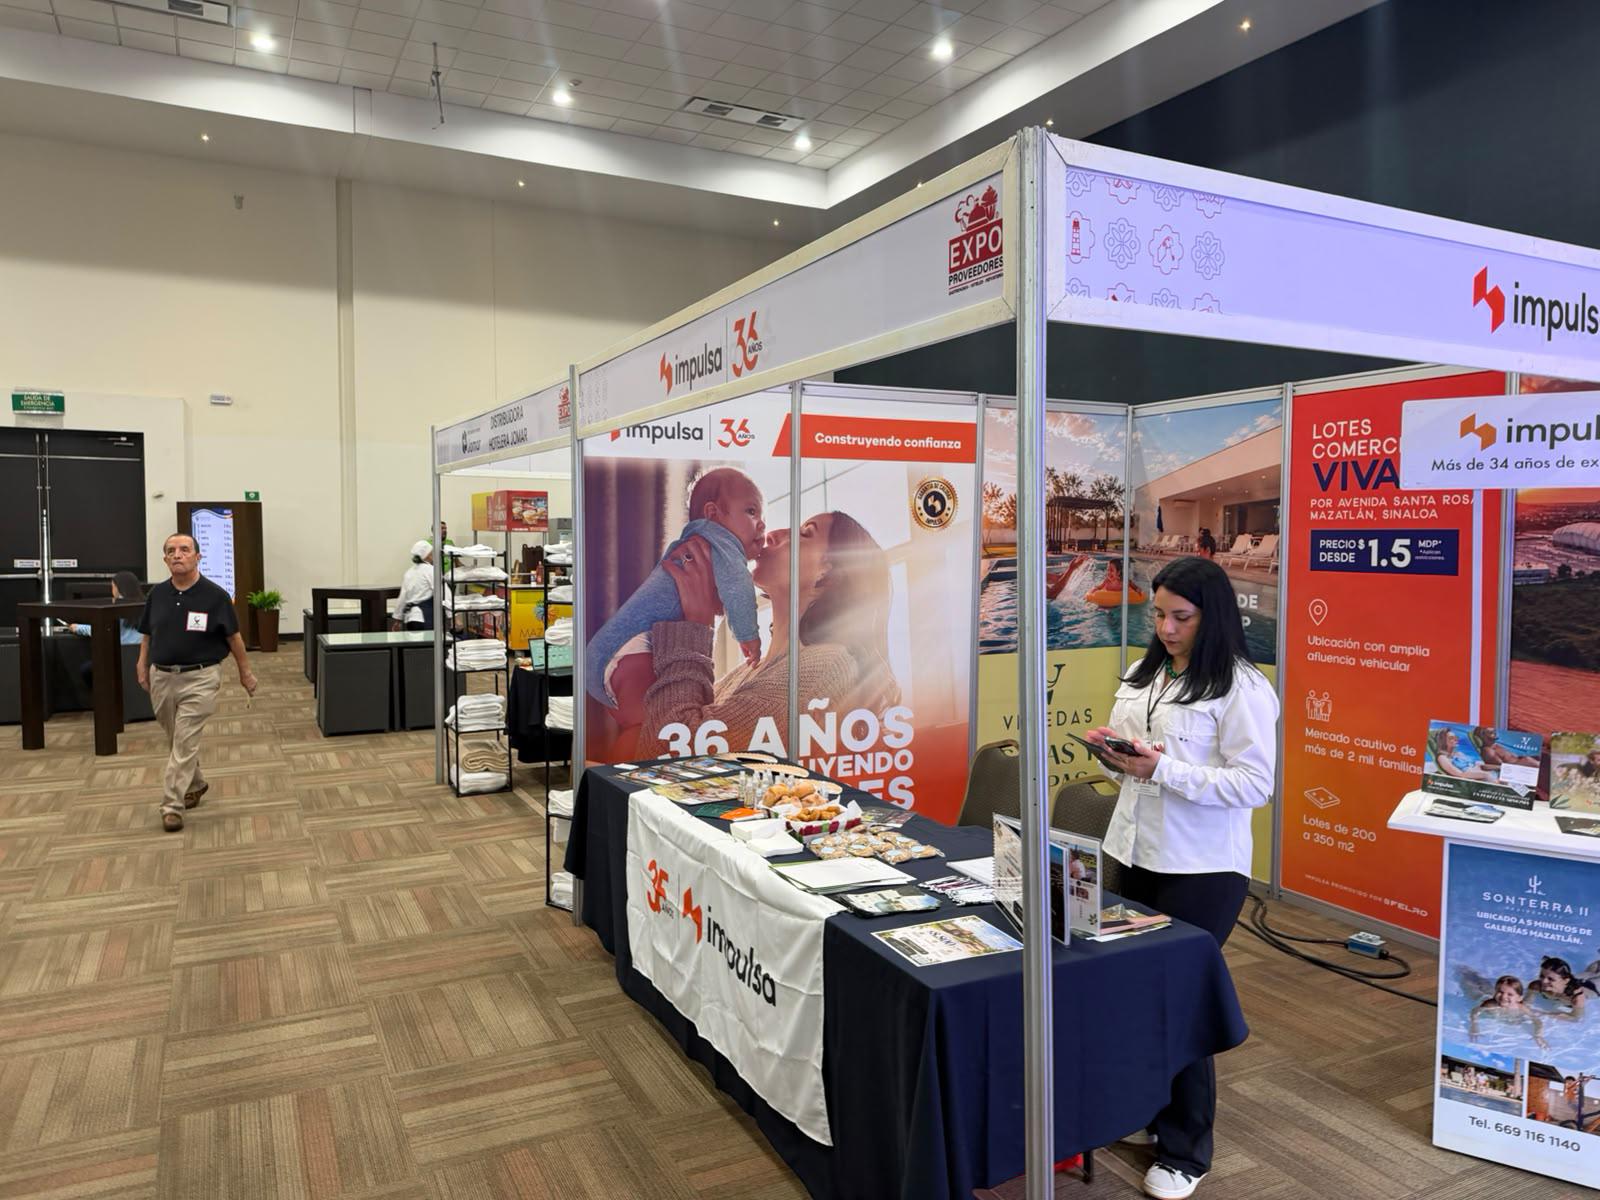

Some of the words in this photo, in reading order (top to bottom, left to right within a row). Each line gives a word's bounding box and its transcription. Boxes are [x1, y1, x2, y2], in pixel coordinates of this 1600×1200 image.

[950, 225, 1002, 269] EXPO
[948, 255, 1004, 286] PROVEEDORES
[1513, 281, 1600, 342] impuls
[732, 311, 758, 377] 36
[748, 341, 763, 354] AÑOS
[674, 342, 722, 390] impulsa
[626, 422, 704, 444] impulsa
[717, 418, 751, 448] 36
[738, 432, 756, 440] AÑOS
[814, 432, 902, 448] Construyendo
[904, 436, 962, 449] confianza
[1312, 418, 1372, 440] LOTES
[1506, 417, 1600, 450] impul
[489, 432, 510, 450] HOTELERA
[1312, 437, 1400, 460] COMERC
[1431, 457, 1462, 472] Más
[1466, 457, 1485, 471] de
[1489, 457, 1509, 470] 34
[1513, 456, 1551, 470] años
[1556, 456, 1575, 470] de
[1580, 458, 1600, 469] ex
[1310, 498, 1334, 508] POR
[1338, 497, 1387, 507] AVENIDA
[1393, 495, 1437, 506] SANTA
[1310, 508, 1377, 521] MAZATLÁN,
[1382, 508, 1439, 520] SINALOA
[1319, 539, 1357, 550] PRECIO
[1319, 552, 1356, 563] DESDE
[1307, 635, 1360, 650] Ubicación
[1364, 641, 1385, 652] con
[1389, 643, 1430, 658] amplia
[1307, 651, 1356, 666] afluencia
[1360, 656, 1411, 673] vehicular
[657, 719, 729, 760] 36
[747, 697, 915, 760] AÑOS
[1305, 727, 1350, 745] Mercado
[1354, 736, 1397, 753] cautivo
[1400, 743, 1417, 757] de
[1304, 743, 1326, 756] más
[1330, 746, 1344, 759] de
[1347, 751, 1355, 762] 2
[1358, 752, 1374, 766] mil
[1379, 756, 1423, 775] familias
[1303, 814, 1331, 831] Lotes
[1334, 820, 1349, 836] de
[1351, 828, 1377, 842] 200
[1303, 832, 1310, 841] a
[1313, 833, 1335, 847] 350
[1337, 840, 1355, 852] m2
[1482, 891, 1574, 914] SONTERRA
[1579, 906, 1589, 917] II
[1476, 911, 1517, 924] UBICADO
[1533, 920, 1578, 934] MINUTOS
[1578, 927, 1593, 936] DE
[1483, 922, 1529, 936] GALERÍAS
[1529, 929, 1584, 945] MAZATLÁN.
[1468, 1115, 1491, 1130] Tel.
[1494, 1122, 1521, 1137] 669
[1524, 1129, 1545, 1143] 116
[1549, 1136, 1581, 1152] 1140
